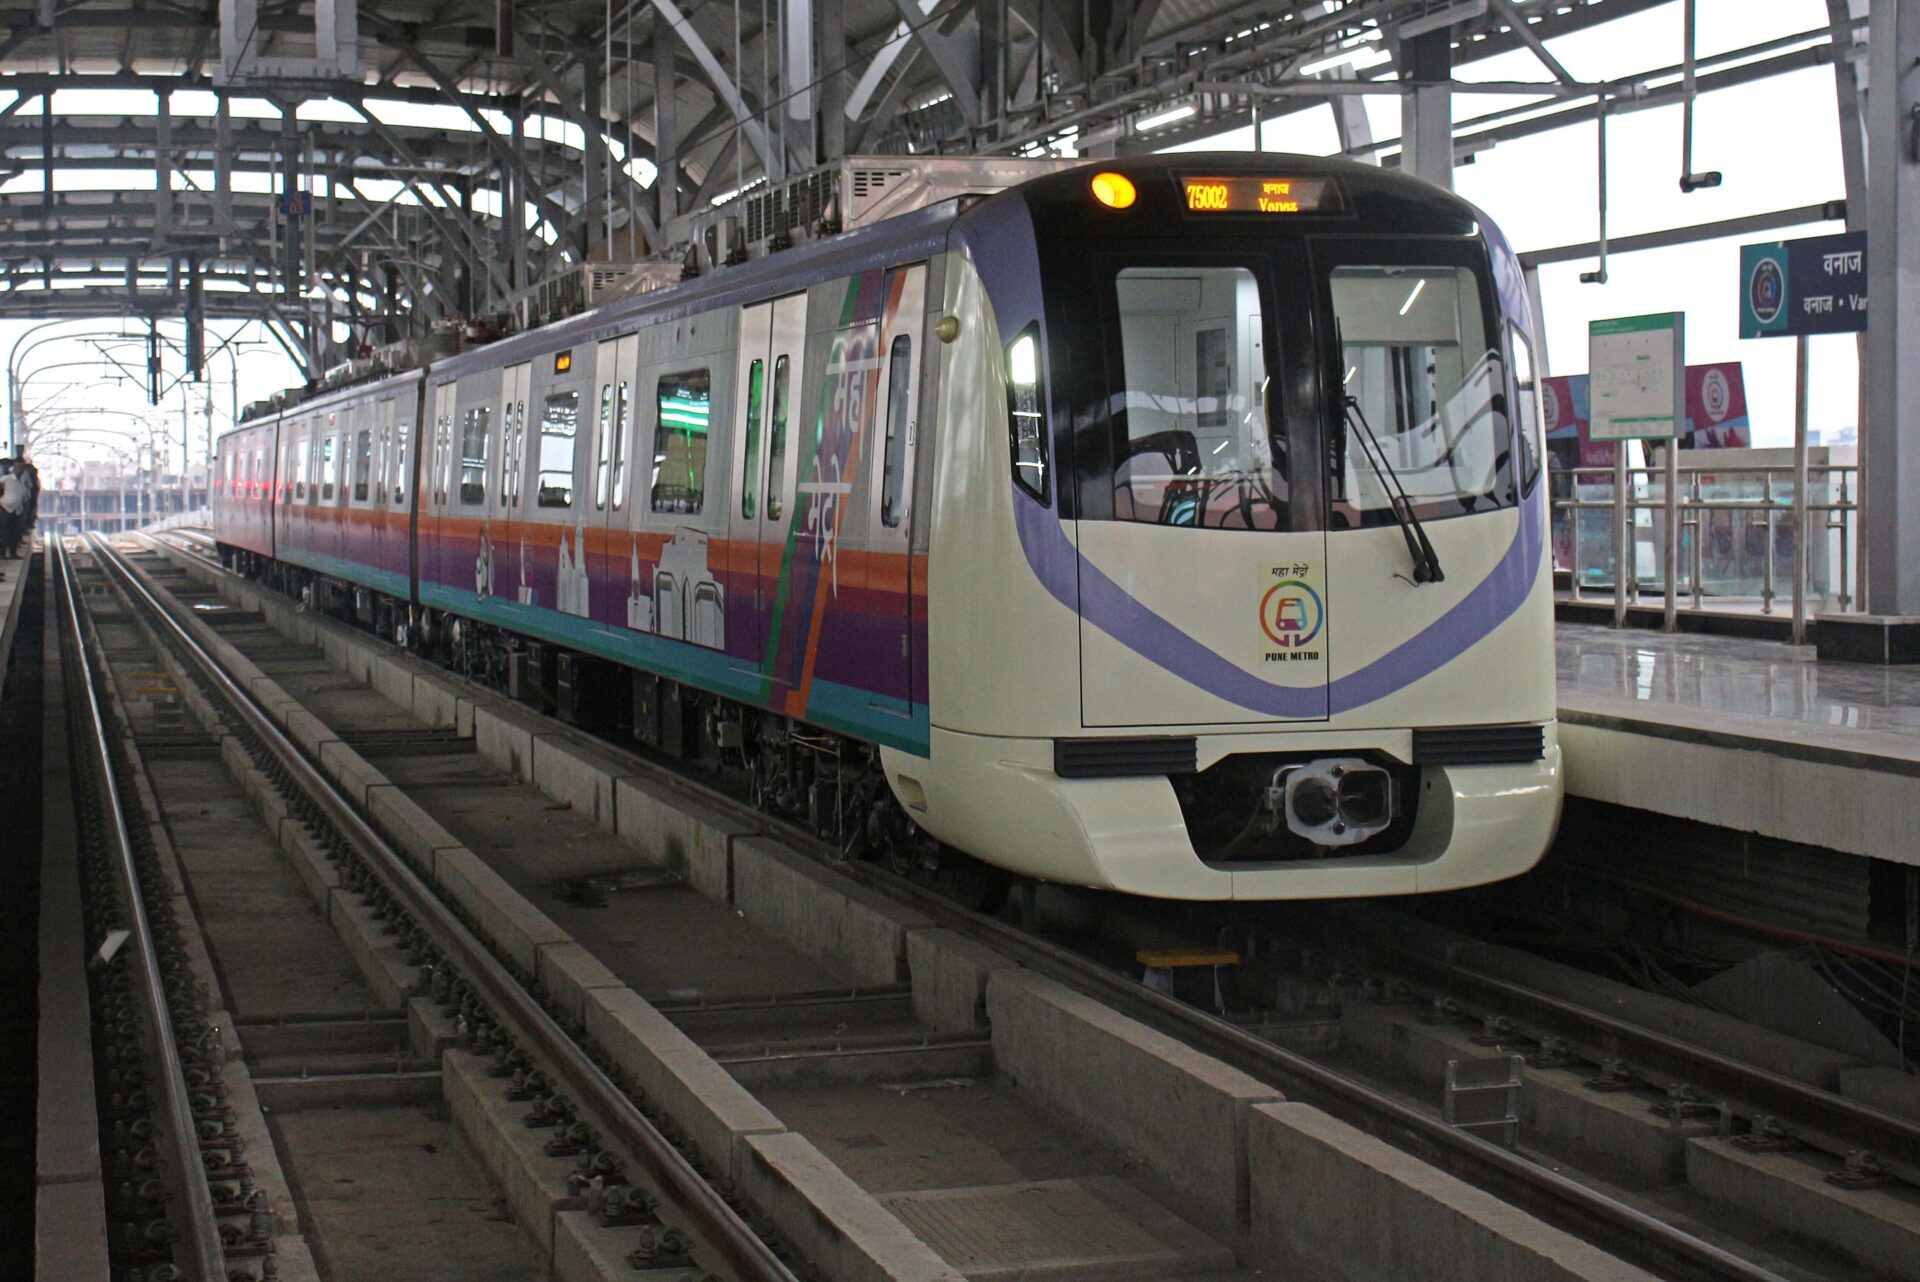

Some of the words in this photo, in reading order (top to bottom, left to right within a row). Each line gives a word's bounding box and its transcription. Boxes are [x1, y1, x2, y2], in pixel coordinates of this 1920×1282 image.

[1187, 185, 1228, 209] 75002
[1258, 197, 1299, 212] Vanaz
[1823, 251, 1862, 275] वनाज
[1803, 296, 1834, 314] वनाज
[1271, 567, 1289, 577] महा
[1292, 563, 1309, 579] मेट्रो
[1265, 652, 1288, 662] PUNE
[1290, 651, 1319, 661] METRO
